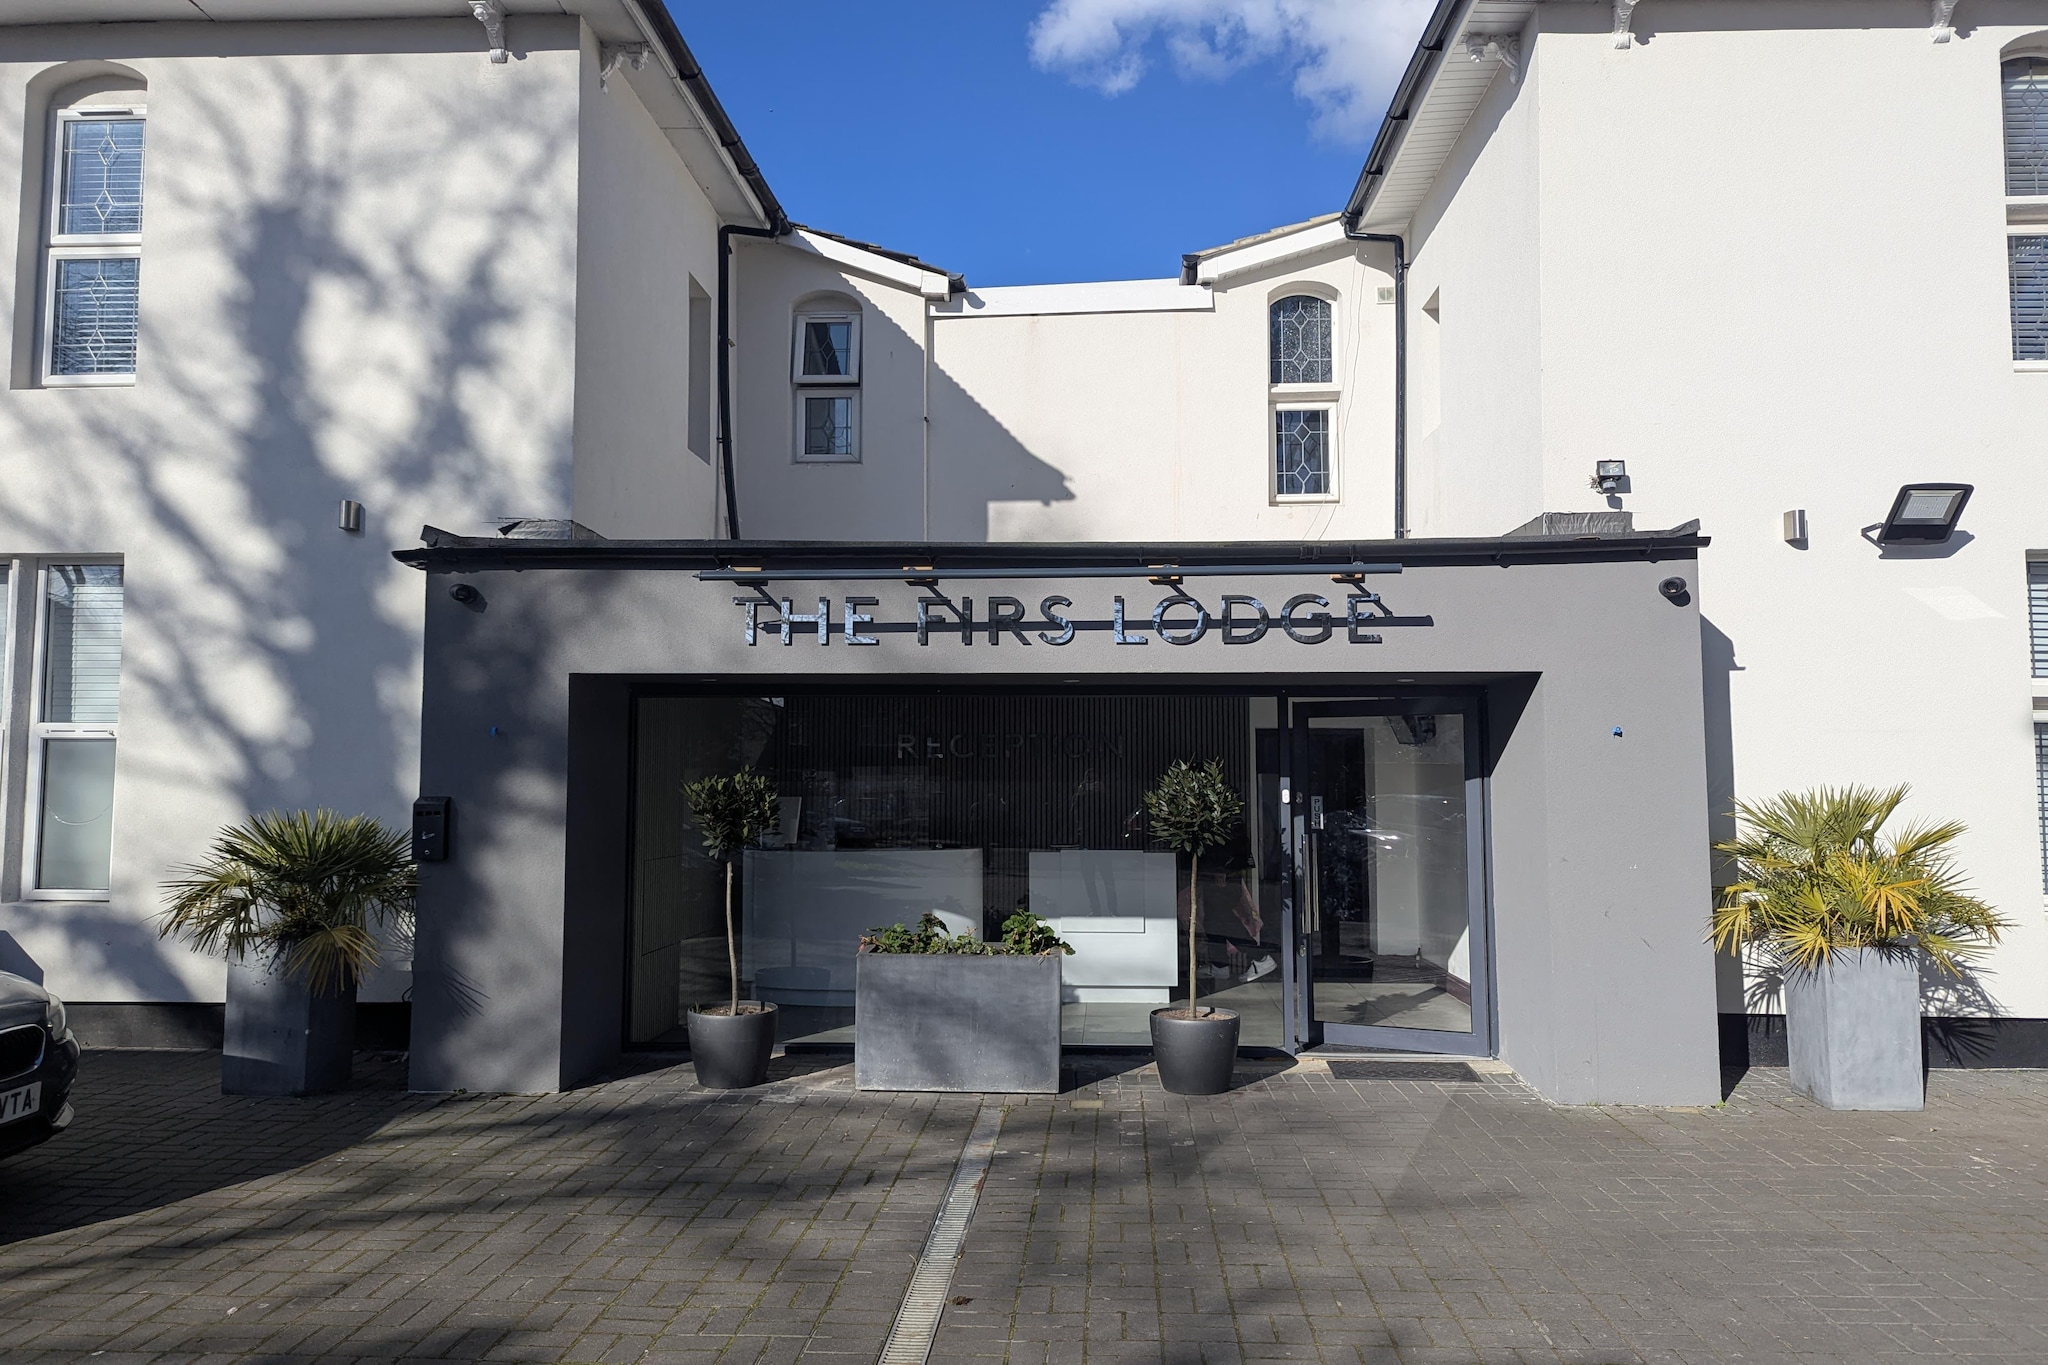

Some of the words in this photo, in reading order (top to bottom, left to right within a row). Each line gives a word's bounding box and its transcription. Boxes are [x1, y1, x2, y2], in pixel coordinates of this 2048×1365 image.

[732, 596, 879, 646] THE
[917, 595, 1075, 646] FIRS
[1114, 593, 1382, 645] LODGE
[897, 733, 1125, 759] RECEPTION
[1313, 798, 1321, 827] PUSH
